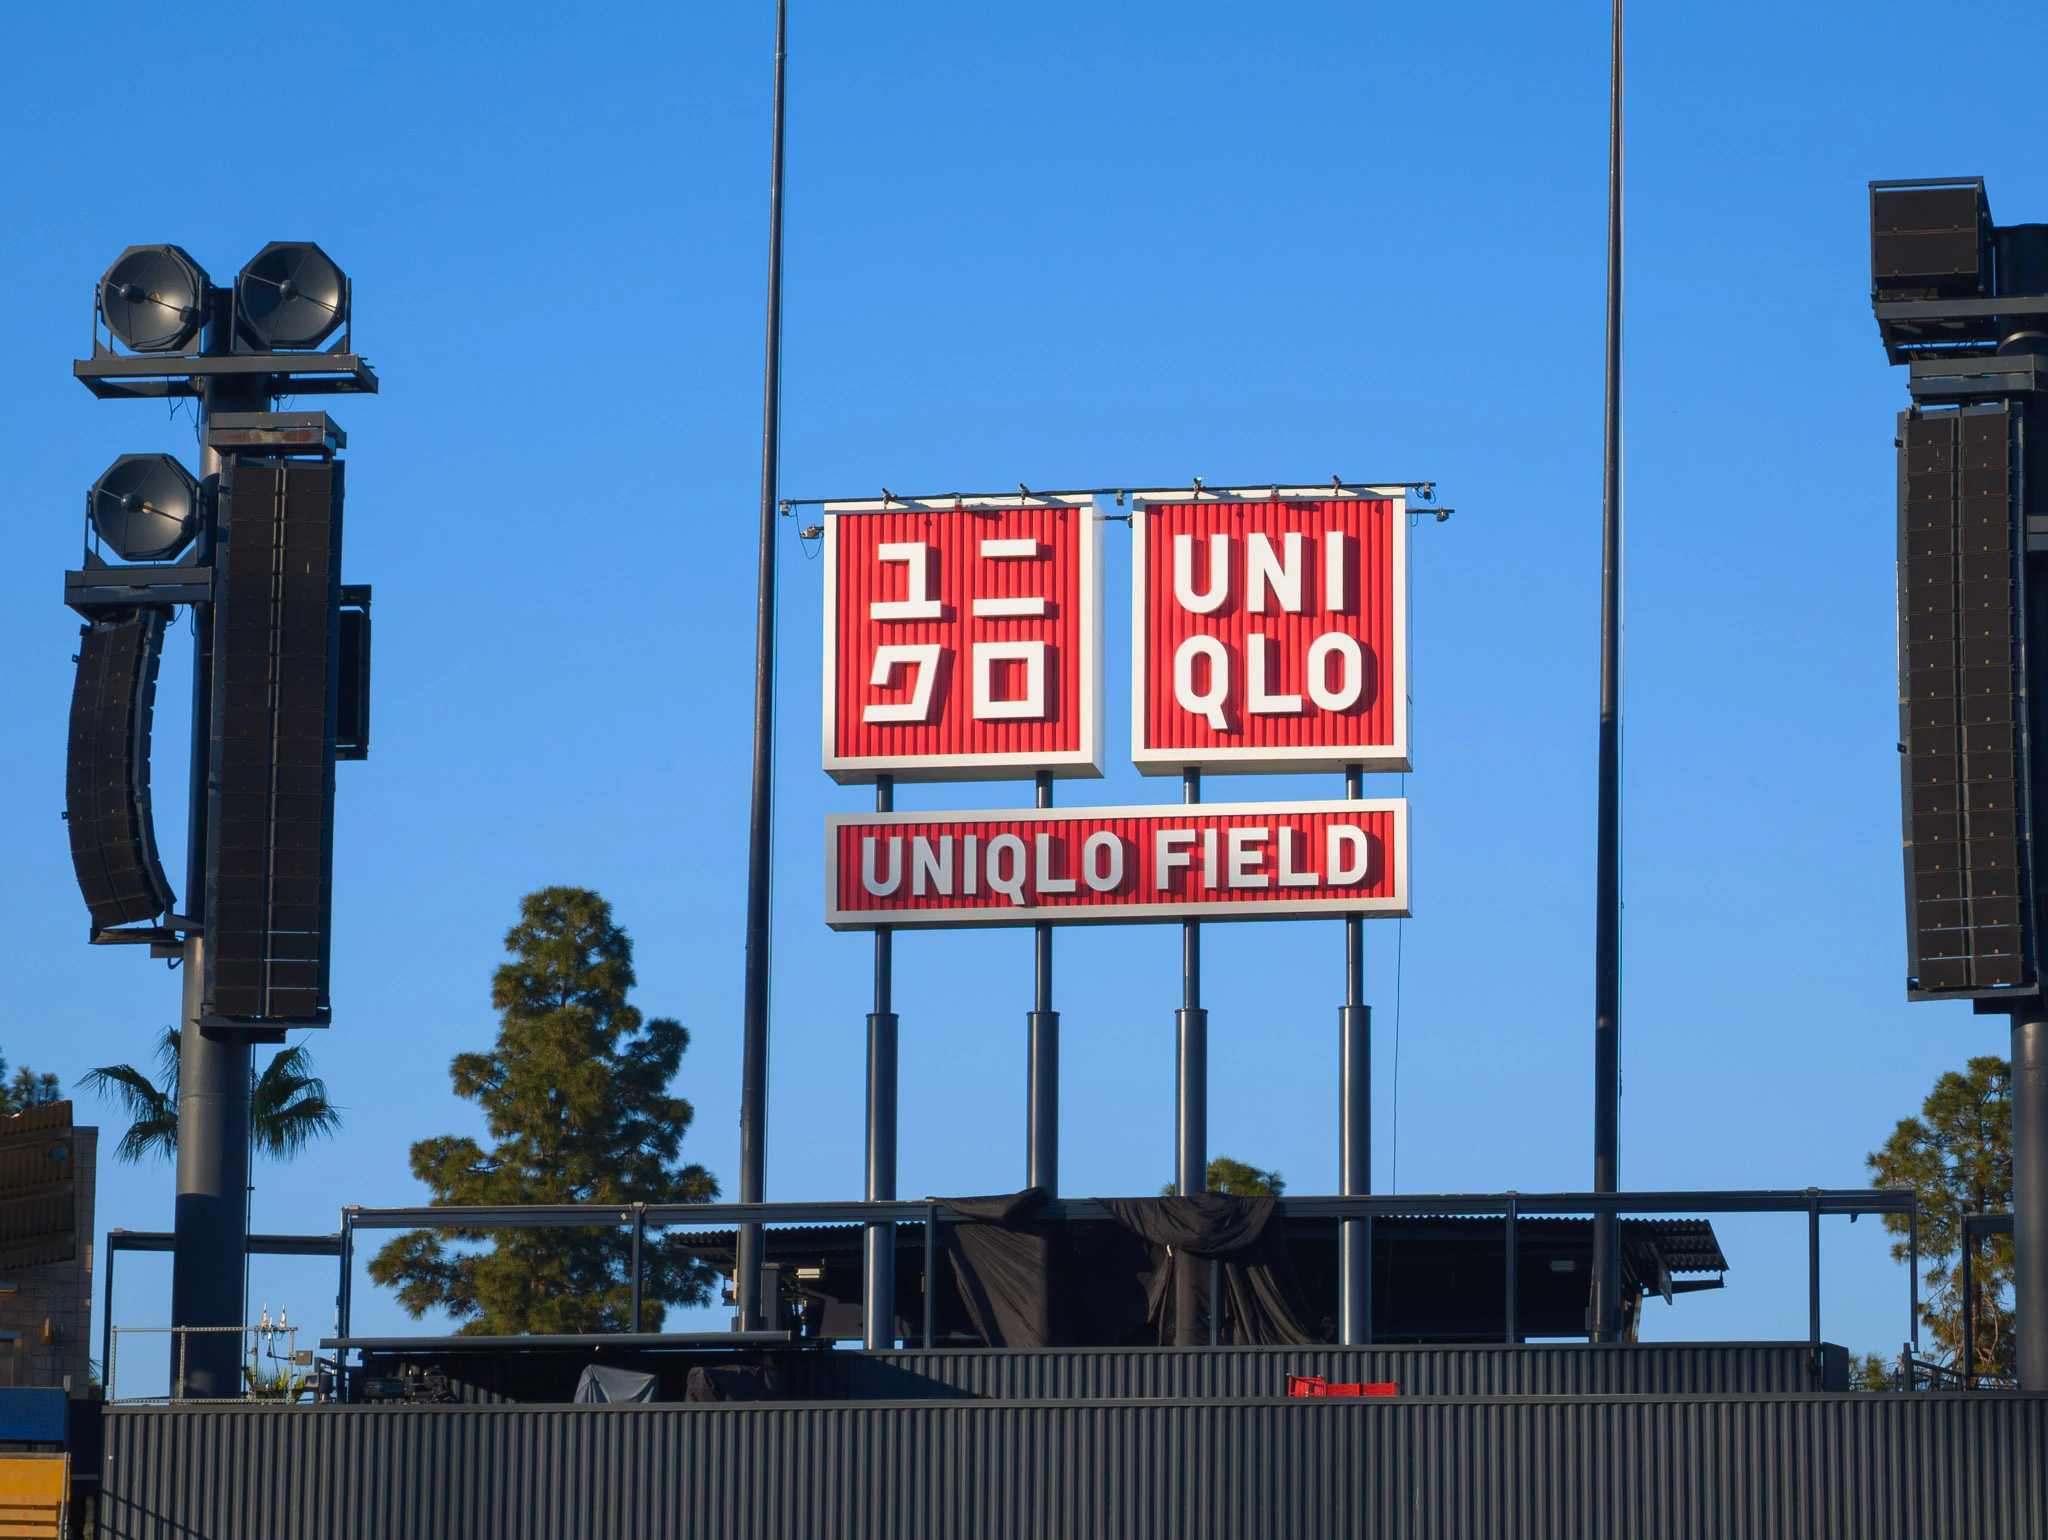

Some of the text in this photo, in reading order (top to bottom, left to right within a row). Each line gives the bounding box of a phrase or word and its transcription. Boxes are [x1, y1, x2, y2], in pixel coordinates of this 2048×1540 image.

[870, 538, 1045, 620] ユニ
[1173, 530, 1344, 615] UNI
[862, 640, 1045, 723] クロ
[1173, 631, 1363, 730] QLO
[861, 824, 1368, 906] UNIQLO FIELD
